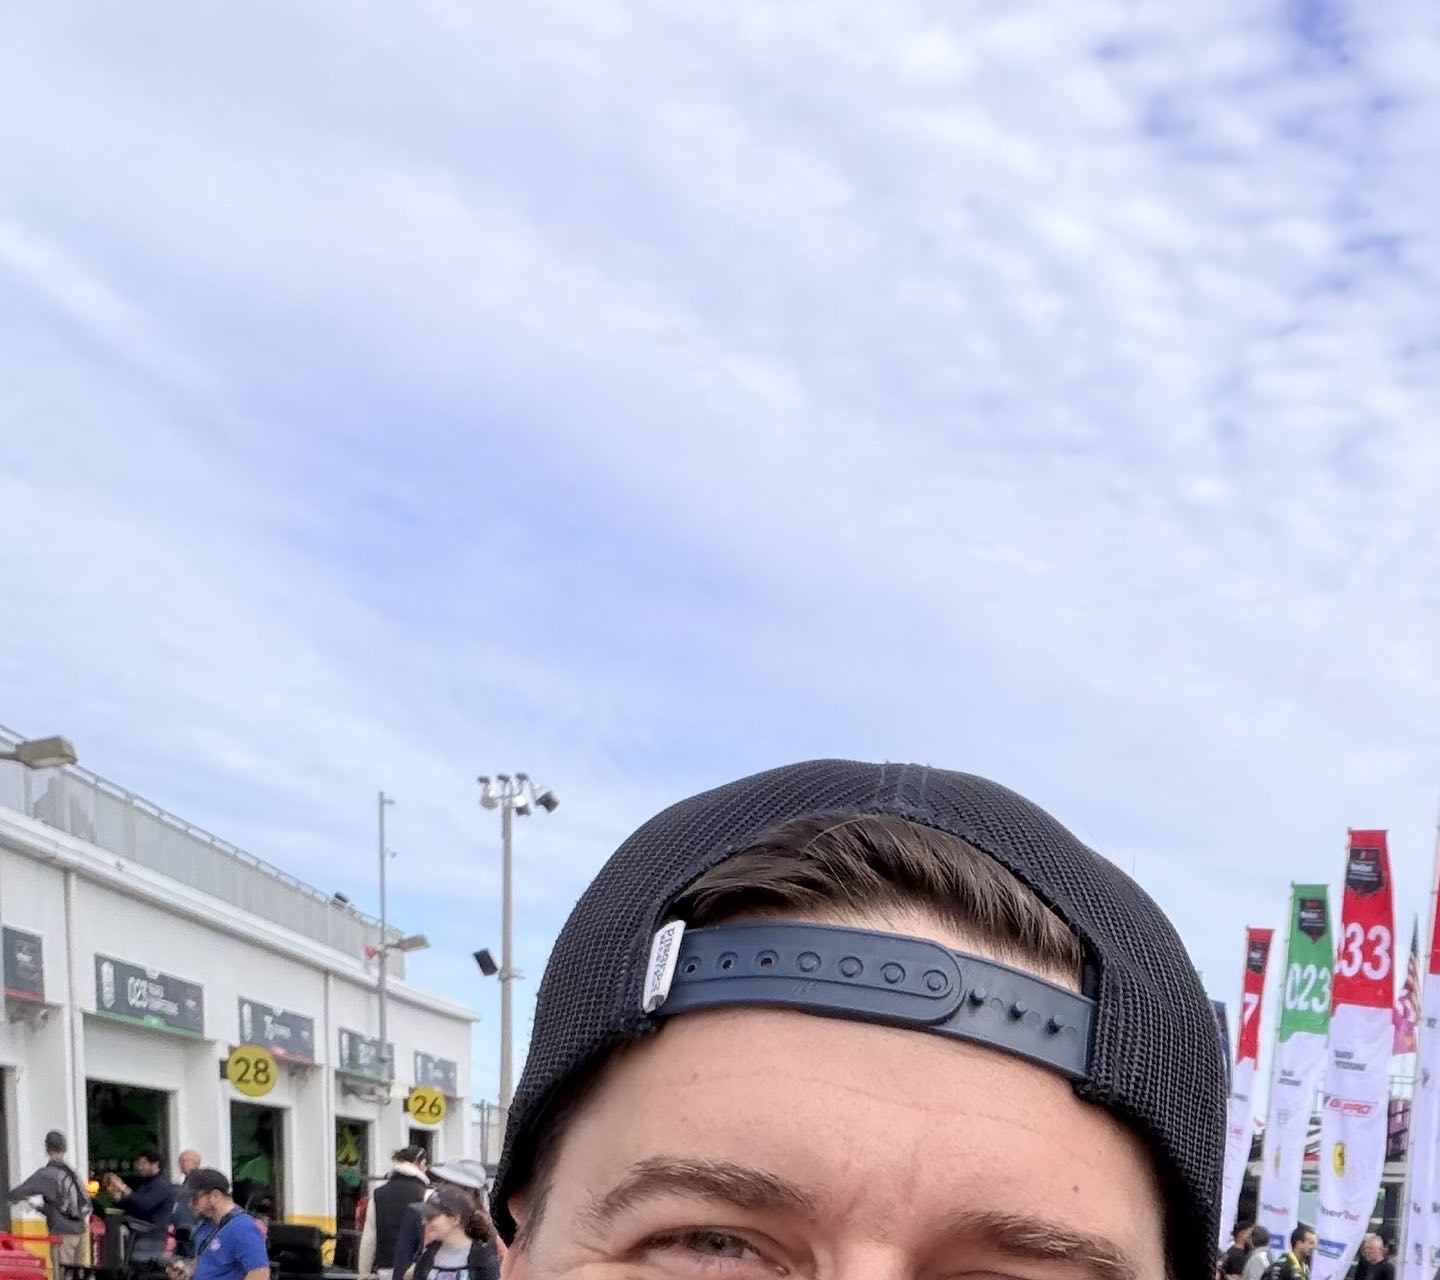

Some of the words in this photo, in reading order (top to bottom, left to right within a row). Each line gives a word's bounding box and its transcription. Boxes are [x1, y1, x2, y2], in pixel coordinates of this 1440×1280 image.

[1285, 963, 1331, 1014] 023
[233, 1056, 271, 1086] 28
[413, 1094, 442, 1119] 26
